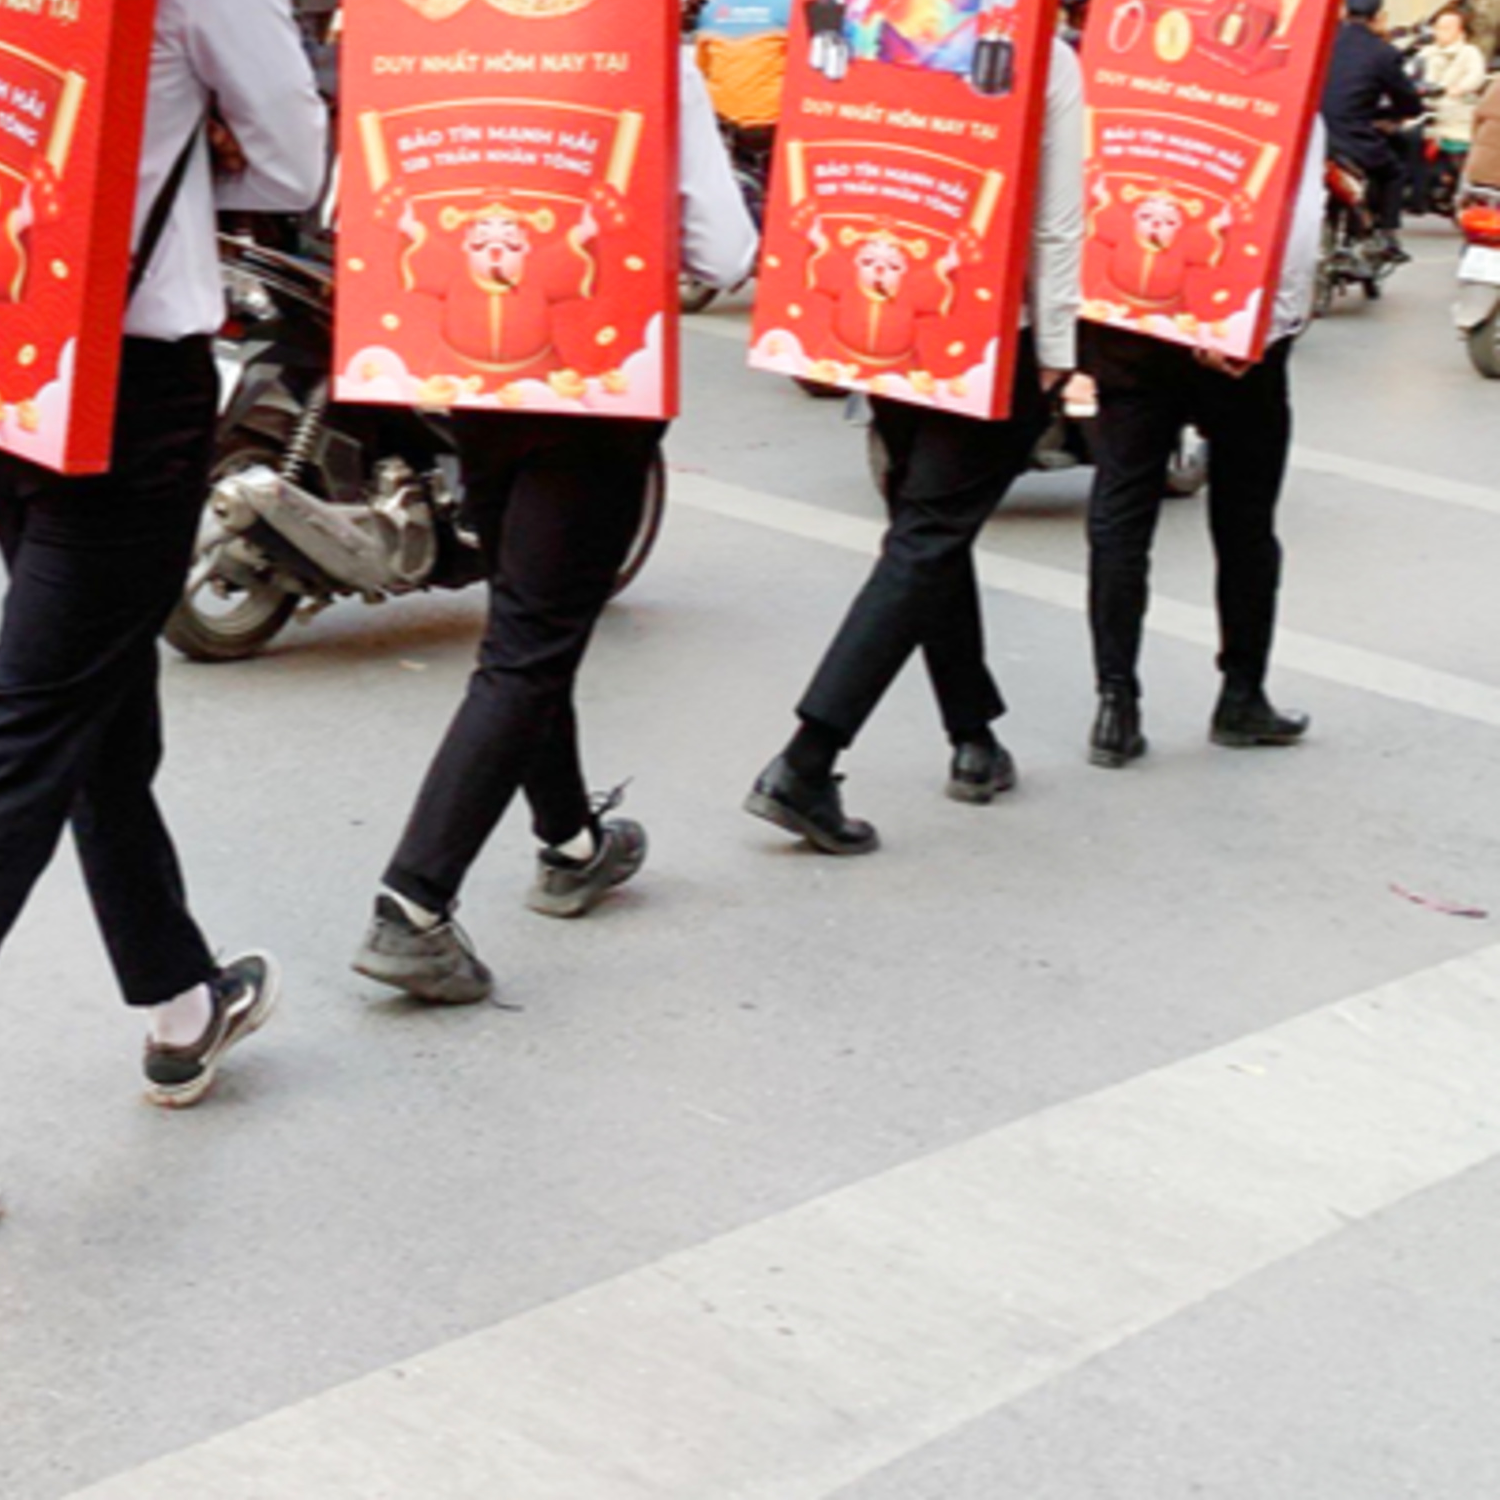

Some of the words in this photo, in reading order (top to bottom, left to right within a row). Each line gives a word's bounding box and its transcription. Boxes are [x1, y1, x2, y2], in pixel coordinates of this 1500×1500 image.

[372, 54, 418, 75] DUY
[483, 48, 537, 74] HÔM
[539, 51, 588, 73] NAY
